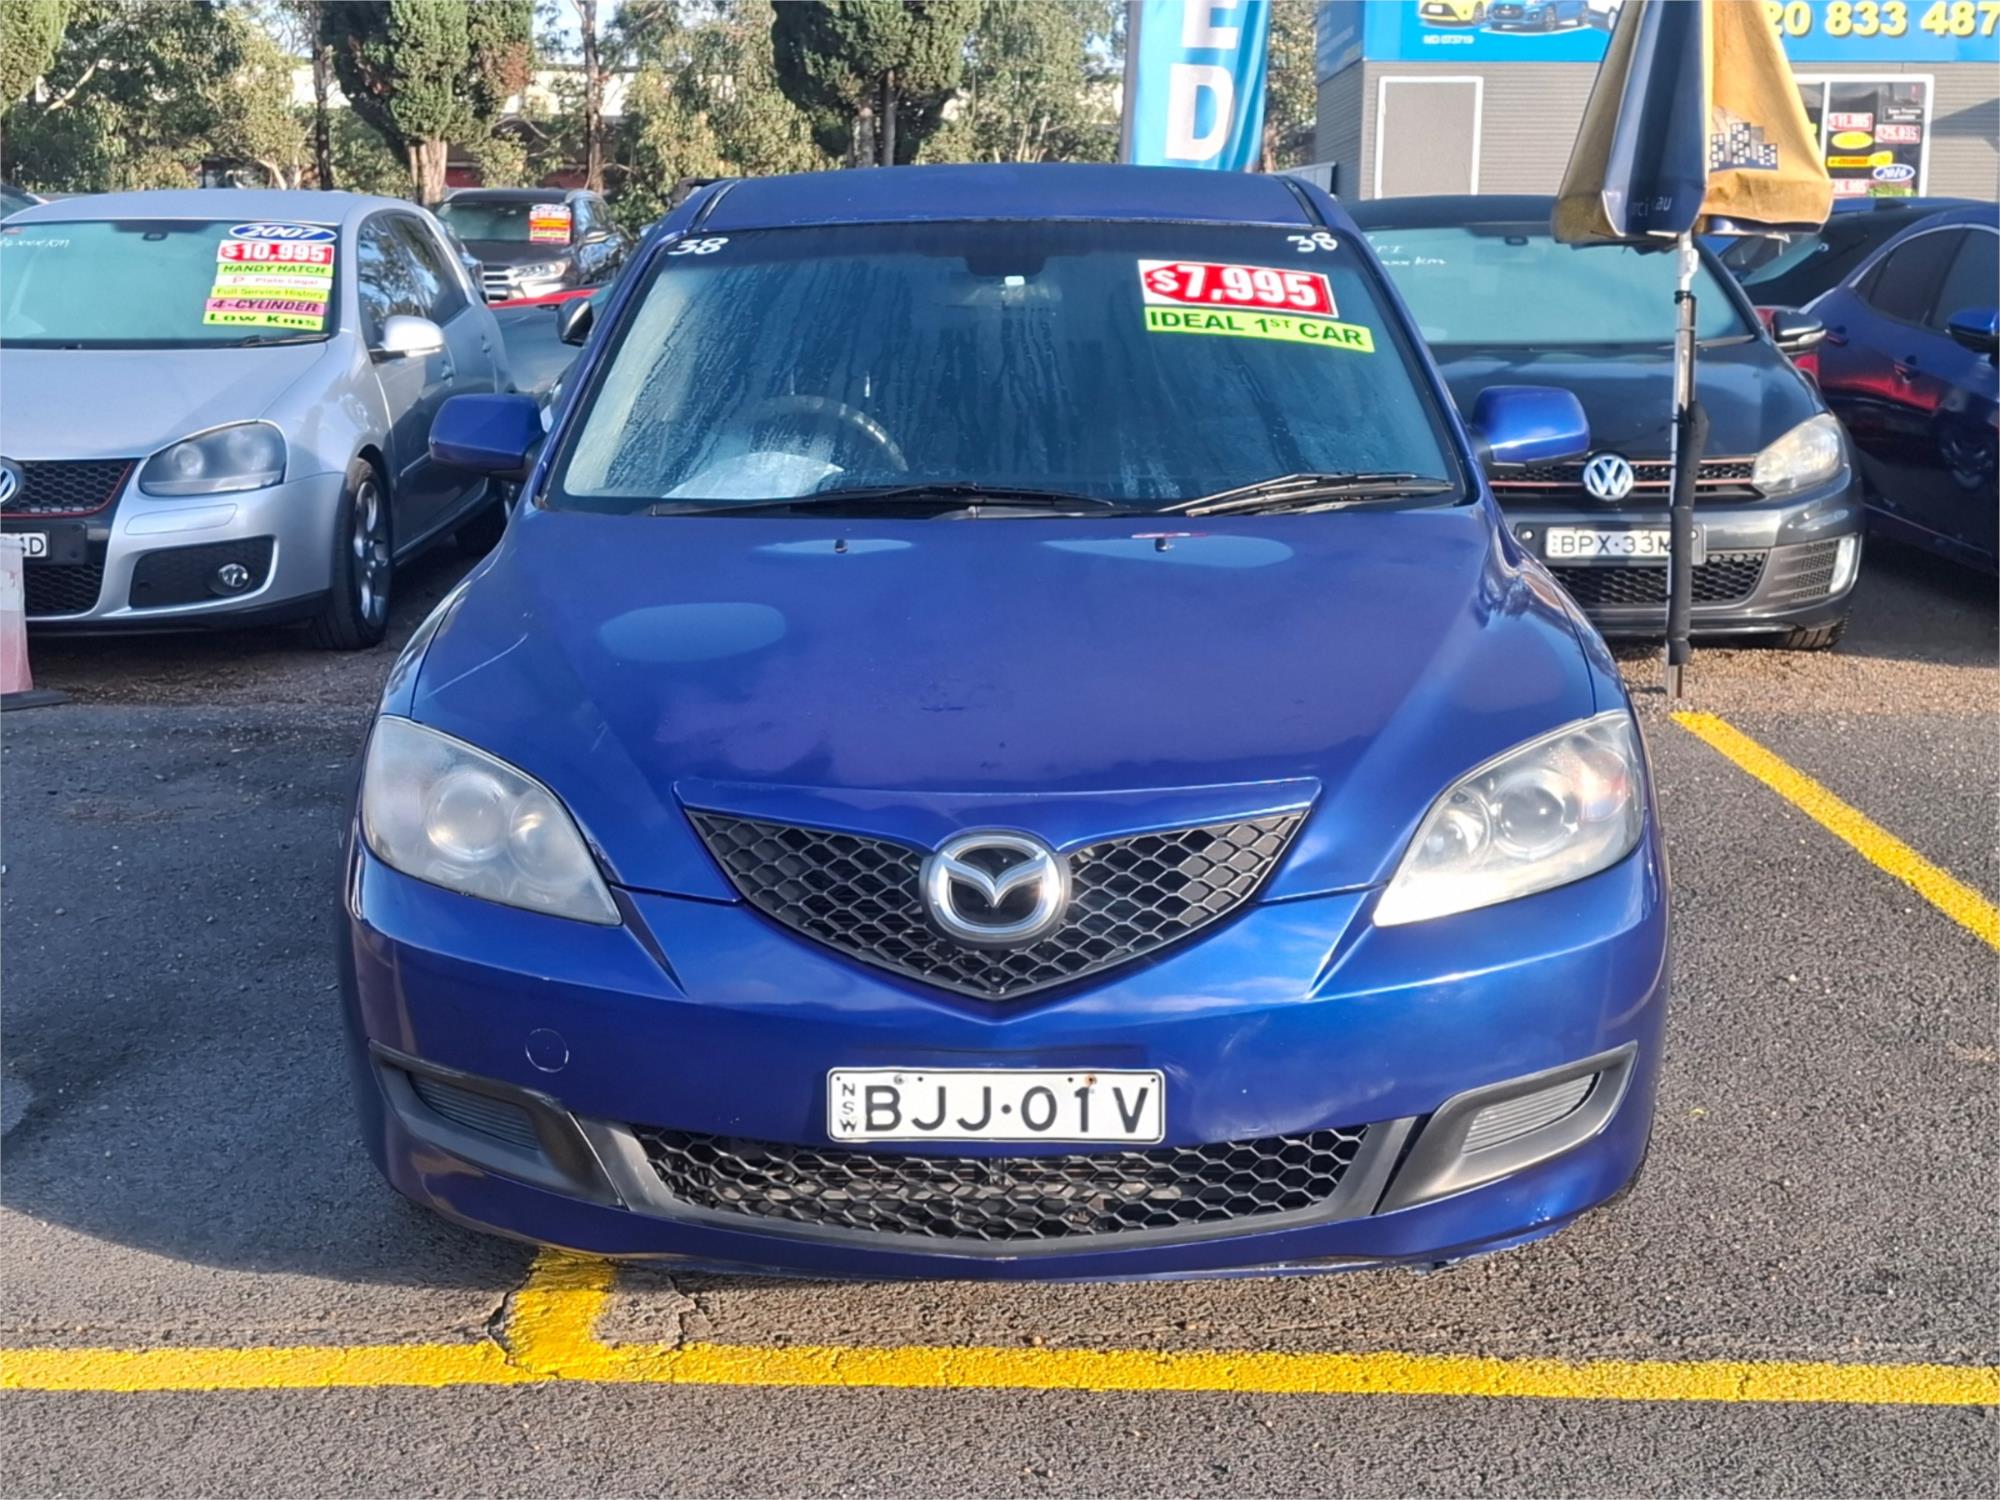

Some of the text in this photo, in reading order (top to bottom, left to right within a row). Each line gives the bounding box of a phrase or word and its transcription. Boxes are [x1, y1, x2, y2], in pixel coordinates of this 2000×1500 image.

[1825, 1, 1907, 37] 833
[1920, 1, 2000, 37] 487
[246, 225, 323, 240] 2007
[1287, 232, 1338, 252] 38
[222, 242, 326, 262] $10,995
[667, 237, 729, 255] 38
[223, 264, 327, 274] HANDY HATCH
[216, 288, 326, 300] Full Service History
[1149, 265, 1318, 307] $7,995
[211, 299, 320, 313] 4-CYLINDER
[1150, 311, 1245, 332] IDEAL
[1299, 322, 1365, 346] CAR
[841, 1083, 857, 1133] NSW
